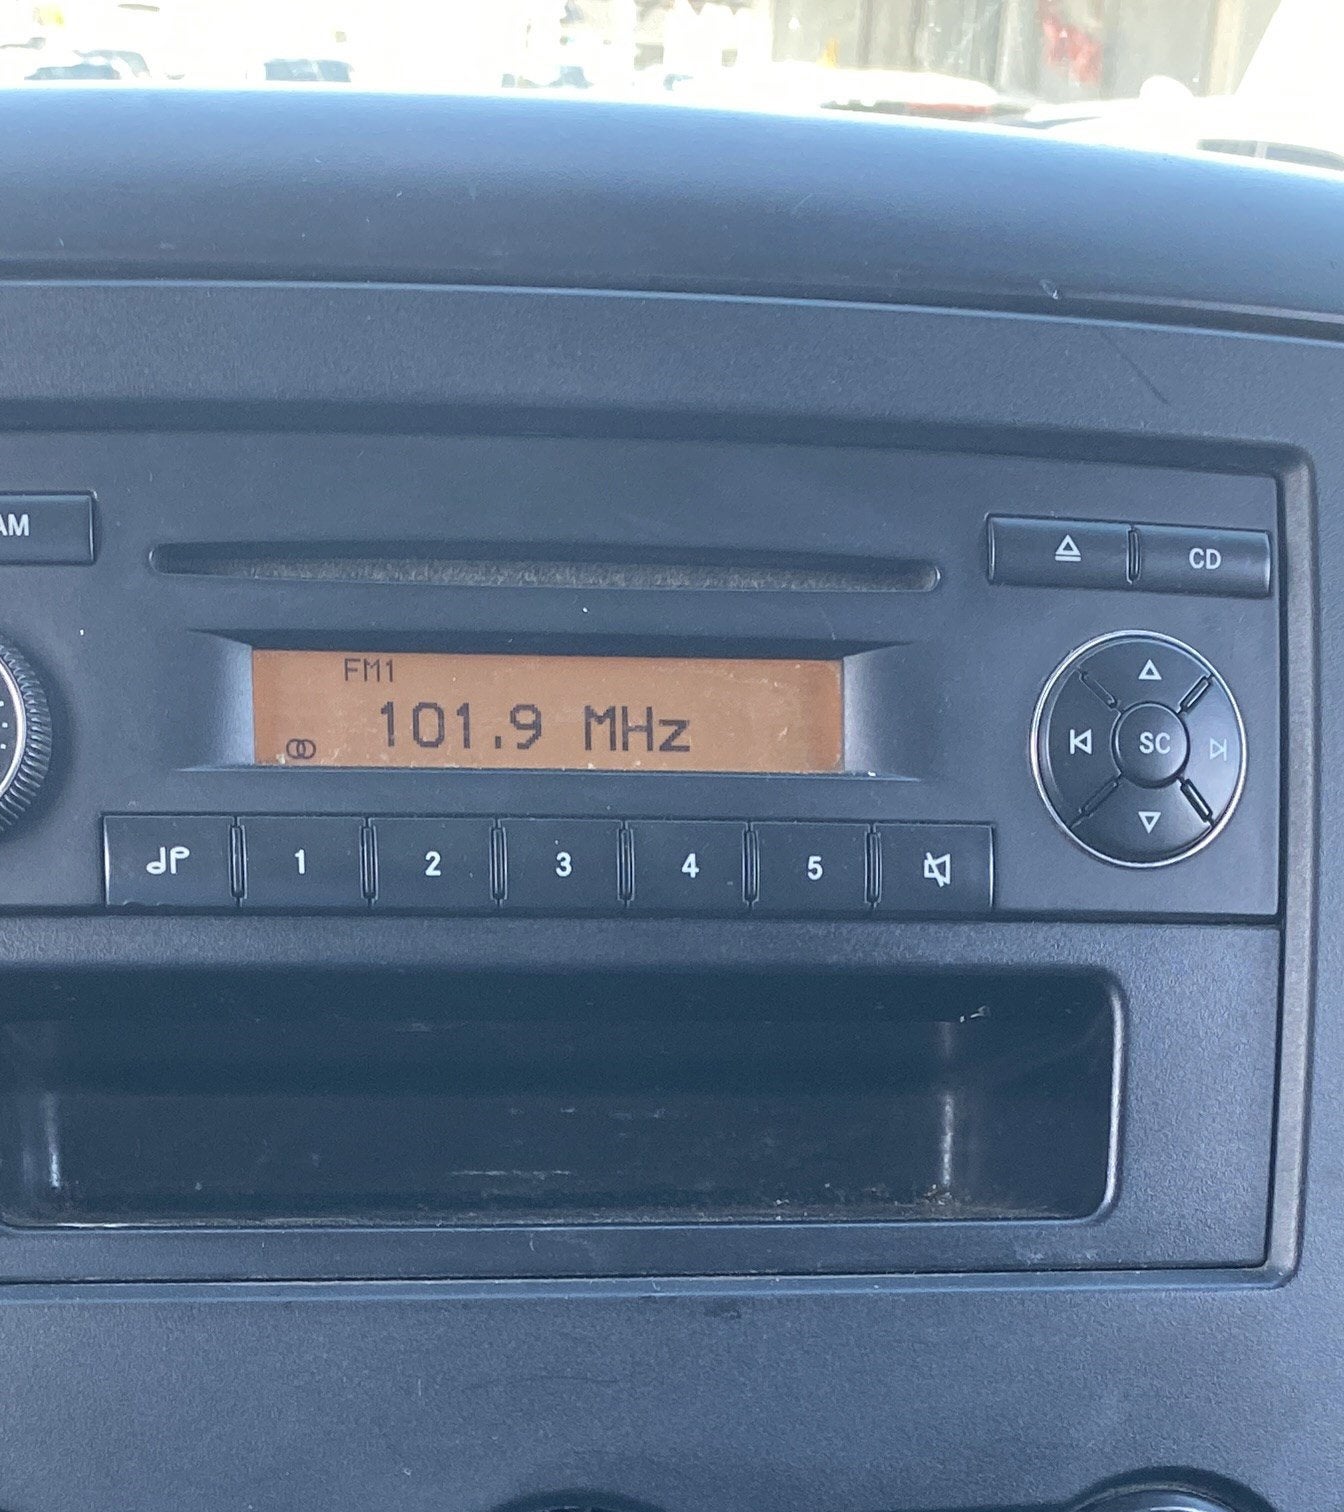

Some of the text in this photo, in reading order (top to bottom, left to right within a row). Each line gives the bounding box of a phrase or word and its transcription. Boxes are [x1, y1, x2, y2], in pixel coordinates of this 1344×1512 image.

[1189, 547, 1223, 571] CD
[343, 657, 396, 684] FM1
[380, 701, 692, 754] 101.9 MHz
[1138, 731, 1172, 755] SC
[293, 849, 306, 875] 1
[424, 851, 442, 877] 2
[554, 851, 573, 878] 3
[680, 853, 701, 879] 4
[806, 854, 824, 881] 5
